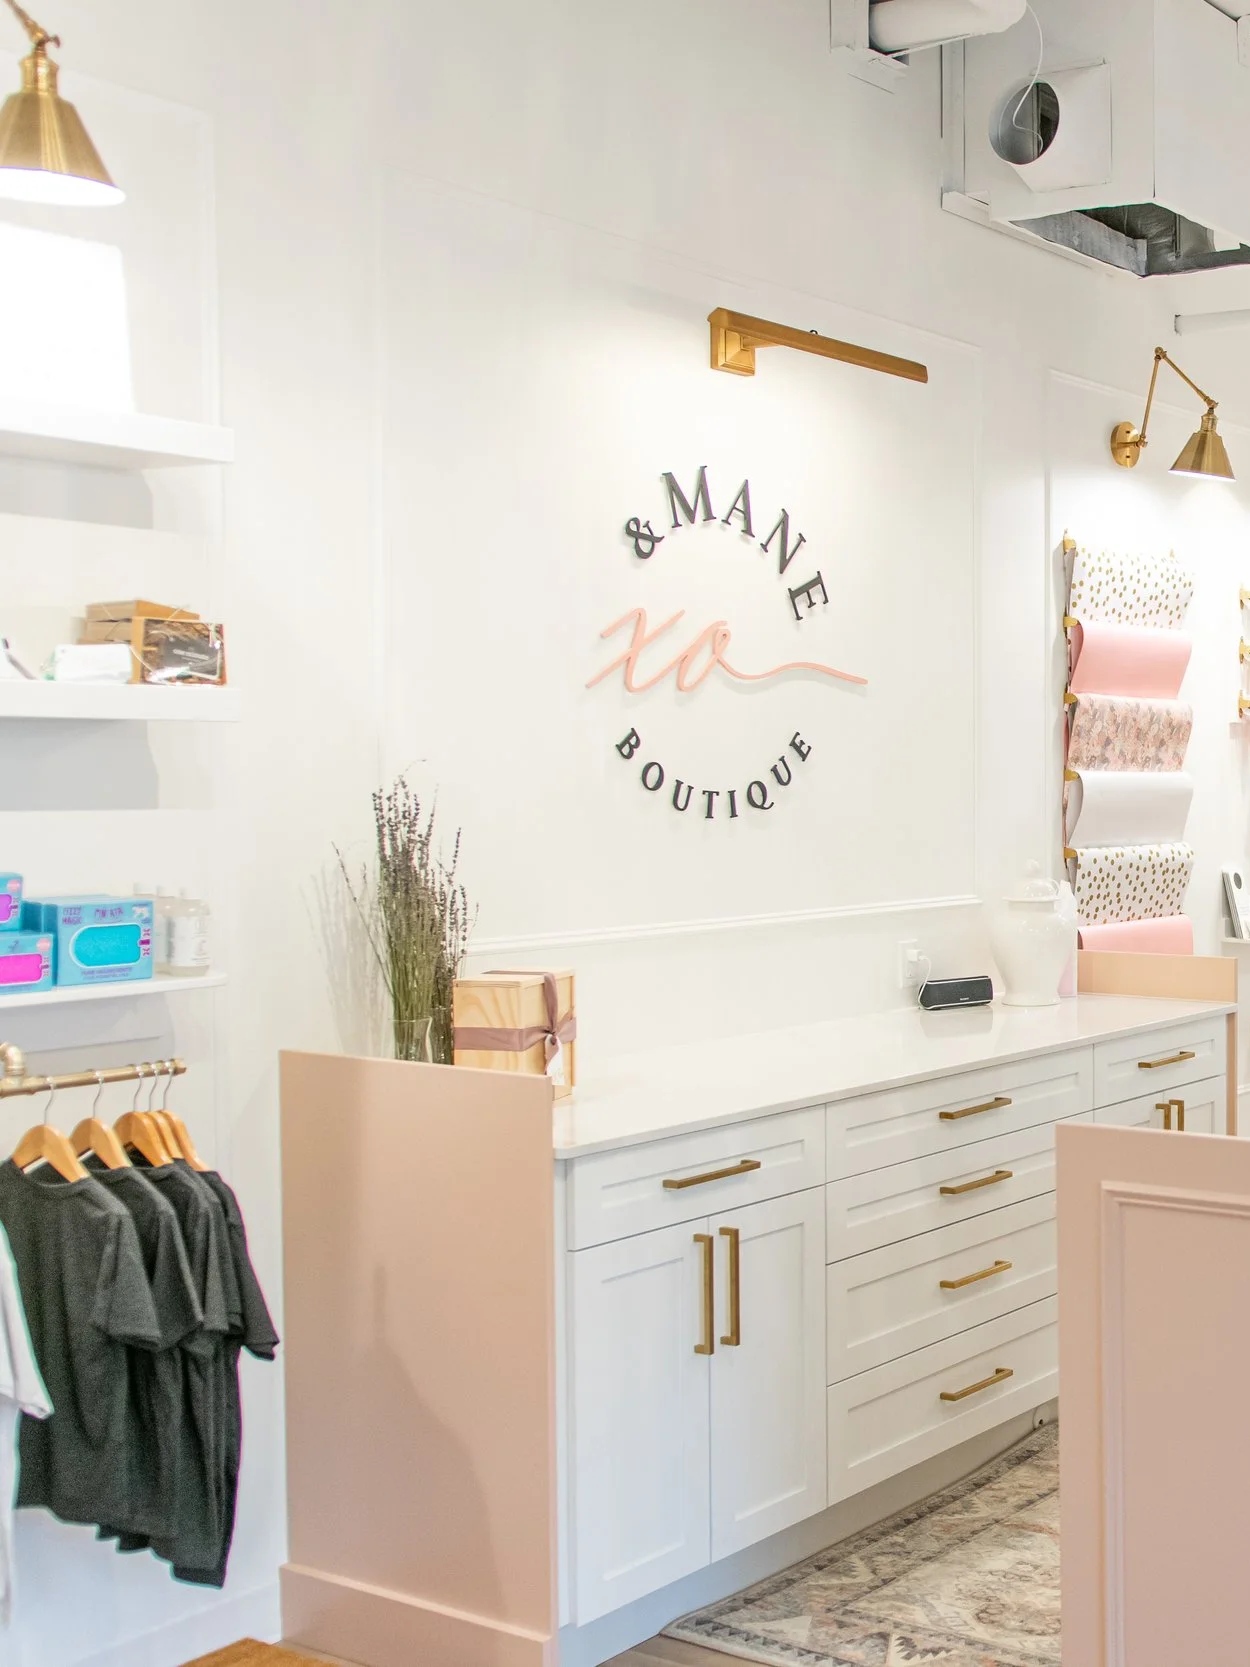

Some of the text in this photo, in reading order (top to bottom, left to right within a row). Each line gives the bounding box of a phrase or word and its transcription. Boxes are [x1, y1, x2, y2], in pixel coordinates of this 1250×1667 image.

[624, 465, 830, 621] & MANE
[615, 727, 812, 819] BOUTIQUE
